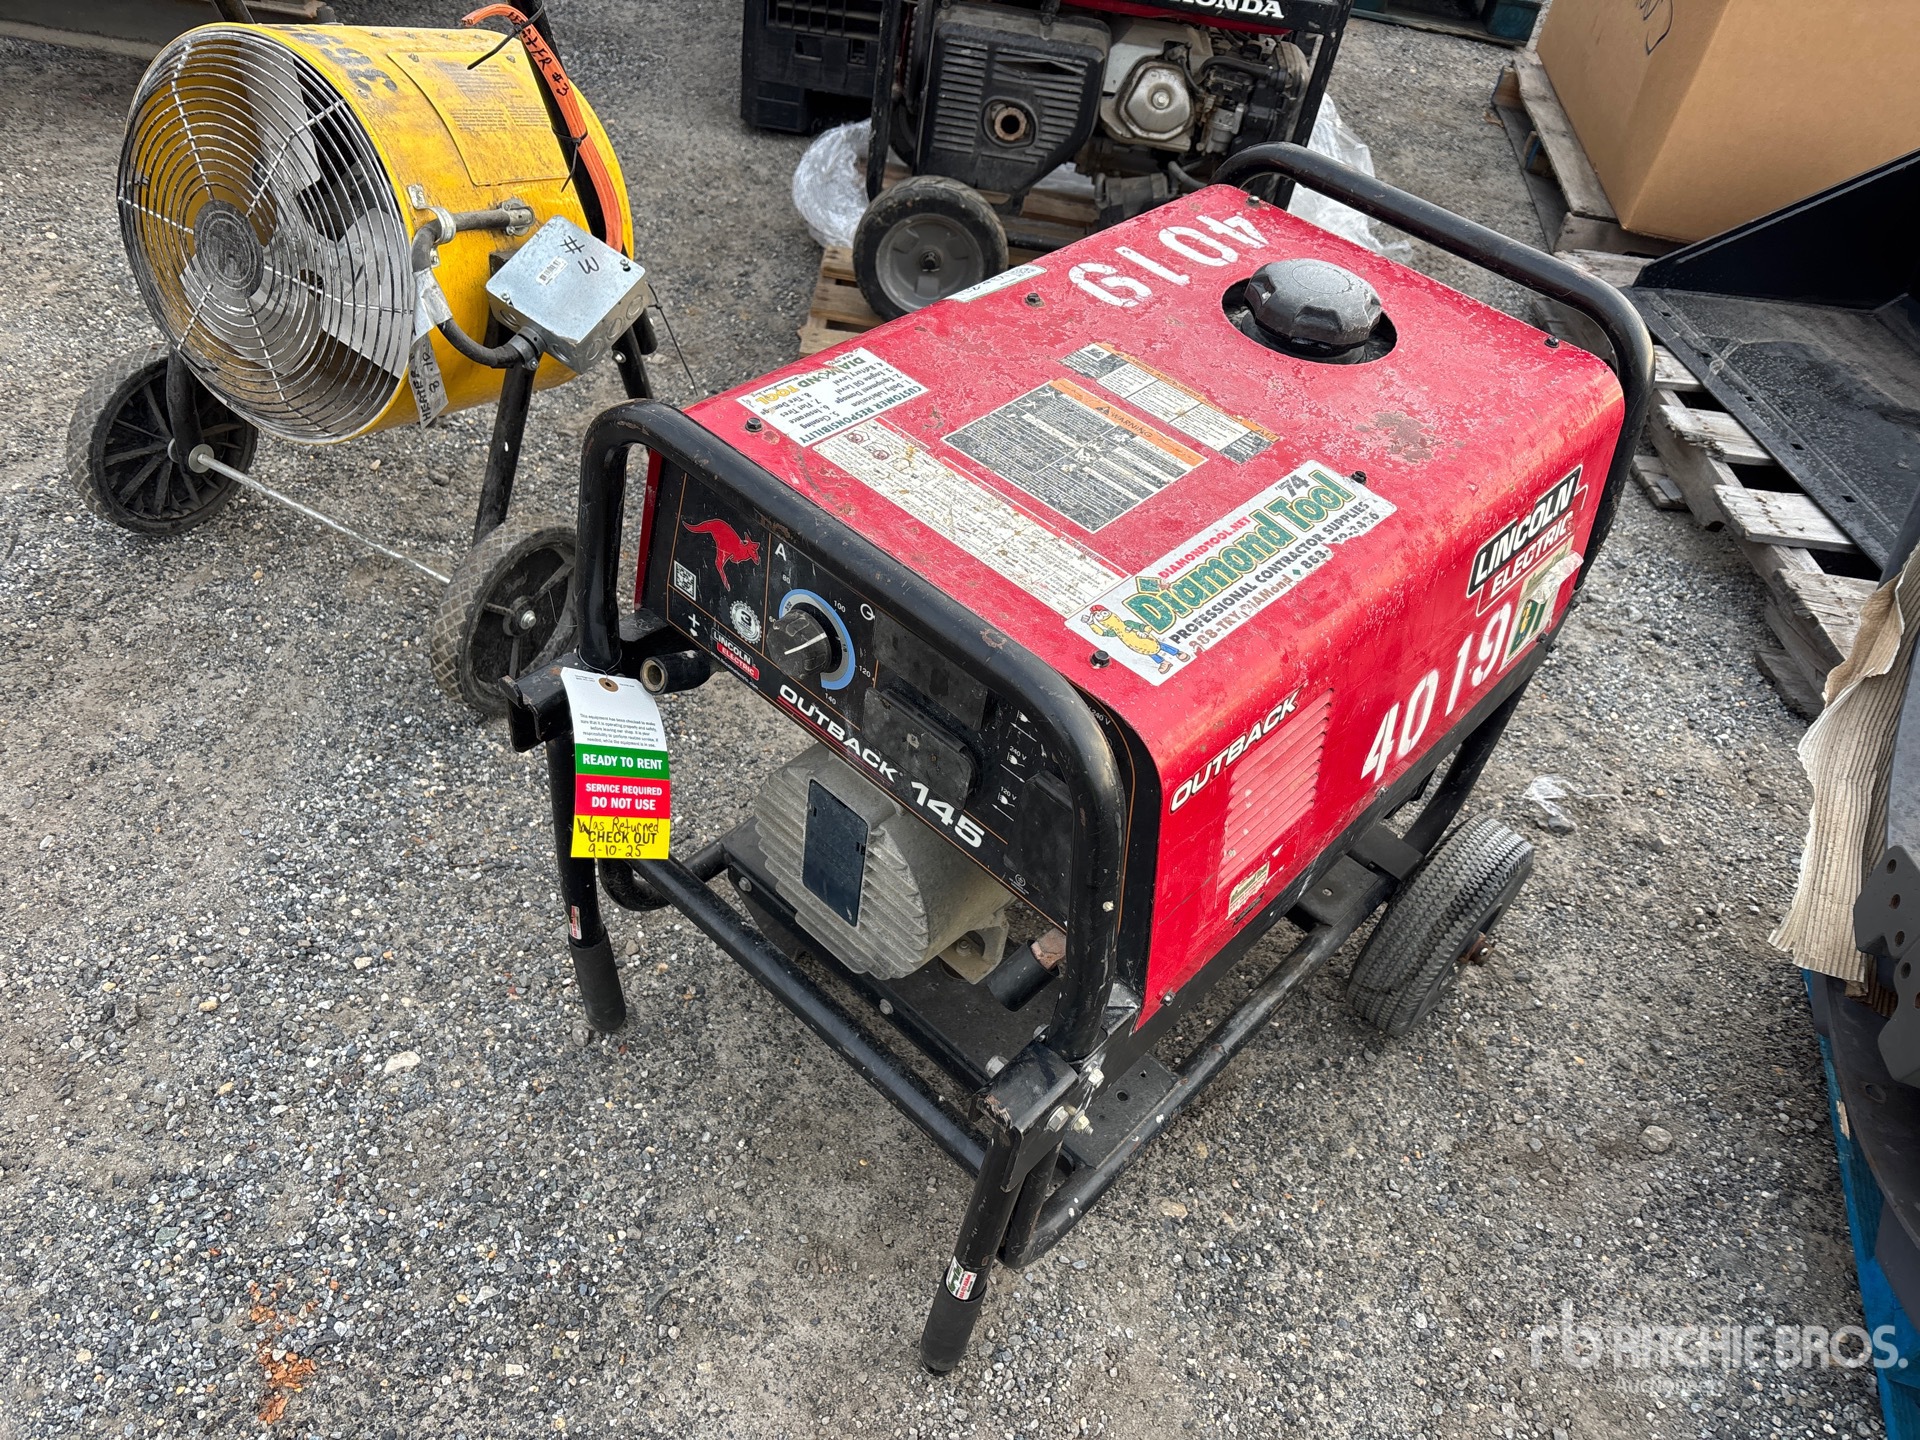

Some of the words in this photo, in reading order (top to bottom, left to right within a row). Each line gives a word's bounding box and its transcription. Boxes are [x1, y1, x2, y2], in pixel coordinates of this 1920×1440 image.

[1069, 212, 1269, 308] 4019
[756, 385, 800, 404] TOOL
[875, 386, 922, 410] CUSTOMER
[799, 406, 874, 444] RESPONSIBILITY
[1110, 410, 1152, 438] WARNING
[1474, 477, 1575, 586] LINCOLN
[774, 542, 787, 561] A
[1122, 508, 1299, 632] Diamond
[1267, 469, 1356, 530] Tool
[1158, 516, 1251, 578] DIAMONDTOOL.NET
[1490, 510, 1573, 598] ELECTRIC
[1168, 582, 1258, 644] PROFESSIONAL
[1255, 534, 1326, 583] CONTRACTOR
[1322, 502, 1369, 535] SUPPLIES
[741, 611, 752, 626] 3
[833, 600, 846, 613] 100
[713, 631, 751, 665] LINCOLN
[722, 648, 755, 677] ELECTRIC
[859, 664, 871, 678] 120
[825, 693, 837, 706] 140
[1361, 602, 1512, 782] 4019
[582, 754, 618, 766] READY
[620, 757, 633, 768] TO
[637, 759, 663, 770] RENT
[1009, 745, 1020, 757] 240
[1170, 690, 1300, 812] OUTBACK
[779, 684, 898, 782] OUTBACK
[911, 780, 985, 848] 145
[585, 783, 620, 794] SERVICE
[622, 785, 662, 796] REQUIRED
[1000, 786, 1011, 797] 120
[592, 796, 607, 808] DO
[611, 798, 632, 809] NOT
[635, 799, 656, 810] USE
[588, 831, 629, 843] CHECK
[634, 833, 657, 844] OUT
